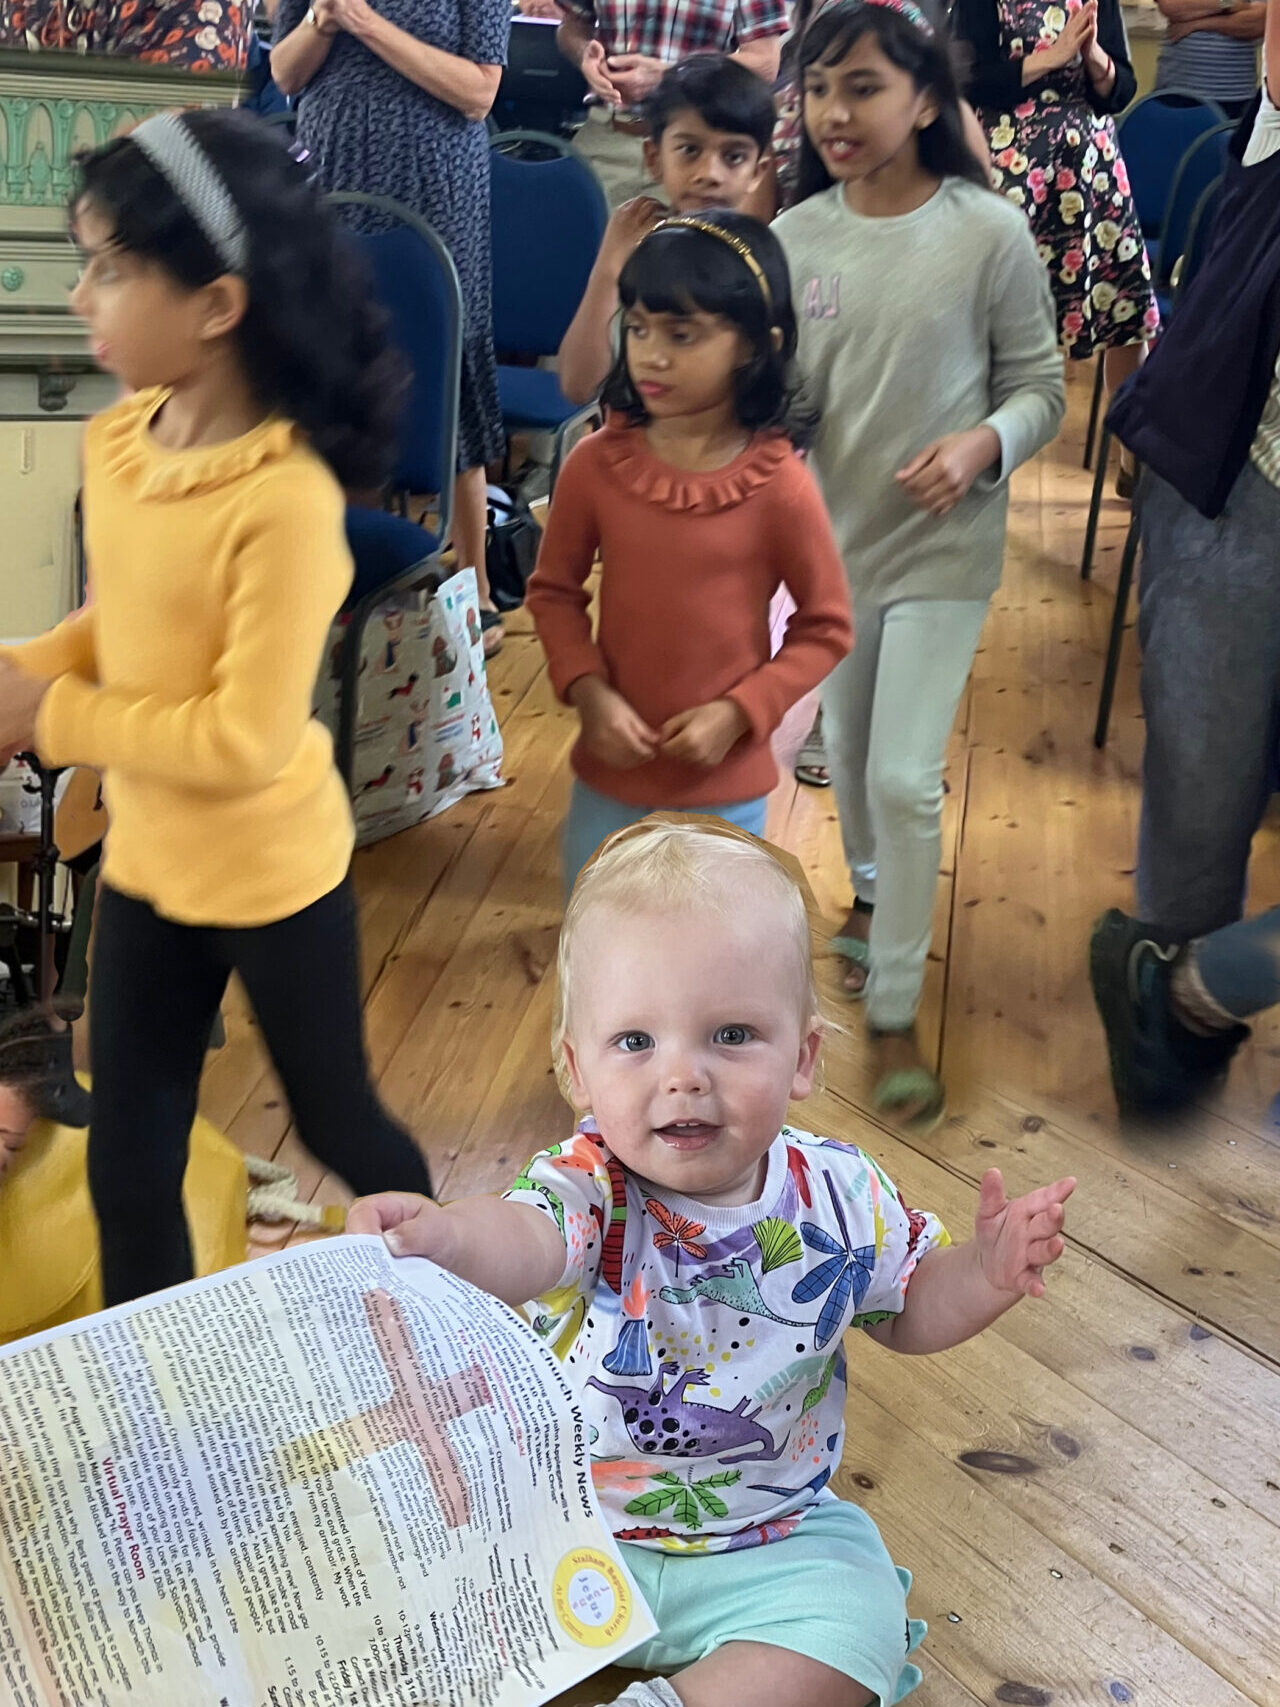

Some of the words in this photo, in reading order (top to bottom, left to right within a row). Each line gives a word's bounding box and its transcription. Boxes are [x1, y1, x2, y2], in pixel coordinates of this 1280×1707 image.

[112, 1318, 131, 1347] desert
[244, 1306, 265, 1341] glowing
[44, 1342, 67, 1384] Saturday
[259, 1341, 272, 1357] log
[132, 1368, 145, 1383] My
[267, 1357, 279, 1372] fire
[538, 1346, 572, 1402] Church
[138, 1384, 156, 1415] energy
[276, 1377, 292, 1404] bathe
[67, 1405, 87, 1437] August
[290, 1414, 302, 1430] the
[304, 1399, 321, 1428] Prayer
[316, 1428, 327, 1441] for
[322, 1442, 340, 1472] Escape
[81, 1438, 95, 1461] Julia
[297, 1431, 315, 1465] warmth
[570, 1405, 587, 1468] Weekly
[162, 1448, 173, 1461] by
[166, 1461, 182, 1490] sandy
[313, 1476, 326, 1498] Your
[95, 1486, 114, 1519] posted
[176, 1489, 190, 1517] winds
[320, 1497, 332, 1518] love
[576, 1471, 594, 1519] News
[101, 1456, 124, 1500] Virtual
[113, 1501, 135, 1542] Prayer
[128, 1542, 147, 1580] Room
[326, 1518, 339, 1536] and
[112, 1536, 128, 1567] Please
[187, 1527, 202, 1559] failure.
[330, 1537, 346, 1565] grace.
[122, 1567, 132, 1585] can
[342, 1564, 357, 1591] When
[125, 1585, 138, 1603] you
[351, 1591, 362, 1607] the
[132, 1602, 147, 1626] keep
[142, 1626, 160, 1662] Thomas
[427, 1610, 448, 1663] Wednesday
[391, 1634, 410, 1676] Thursday
[404, 1677, 418, 1700] 31st
[335, 1658, 354, 1689] Friday
[348, 1690, 359, 1706] 1st
